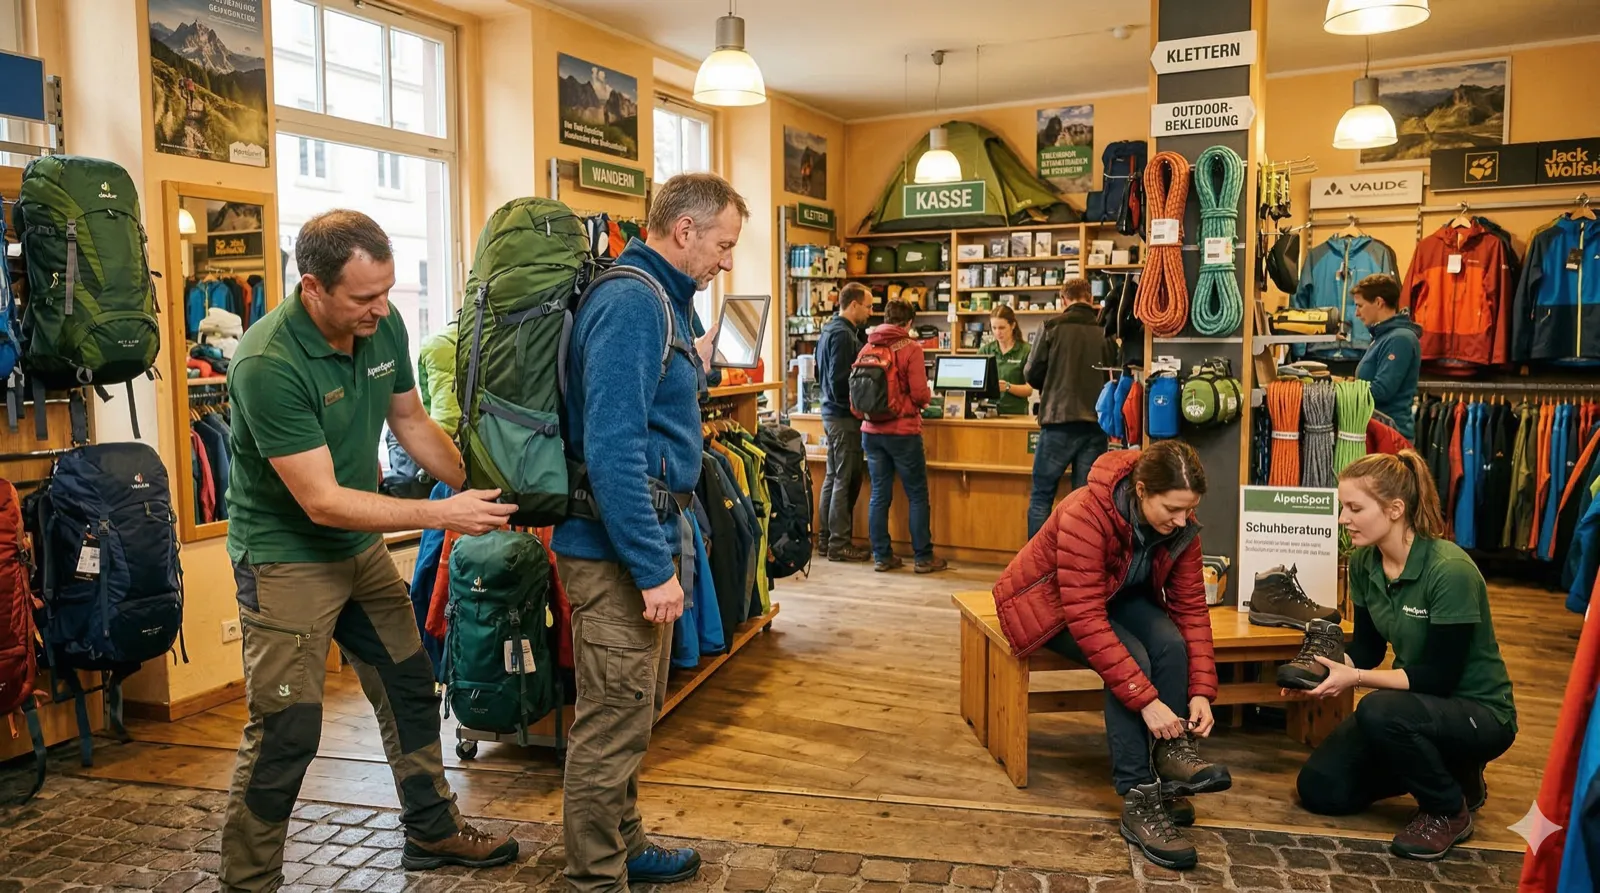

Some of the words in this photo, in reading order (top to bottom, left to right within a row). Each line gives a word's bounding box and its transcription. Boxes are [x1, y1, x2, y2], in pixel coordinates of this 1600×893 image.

[1167, 42, 1240, 64] KLETTERN
[1172, 102, 1233, 118] OUTDOOR-
[1165, 115, 1239, 131] BEKLEIDUNG
[1545, 147, 1588, 164] Jack
[592, 166, 635, 188] WANDERN
[1350, 180, 1408, 192] VAUDE
[916, 189, 972, 210] KASSE
[1273, 492, 1330, 505] AlpenSport
[1246, 522, 1332, 538] Schuhberatung
